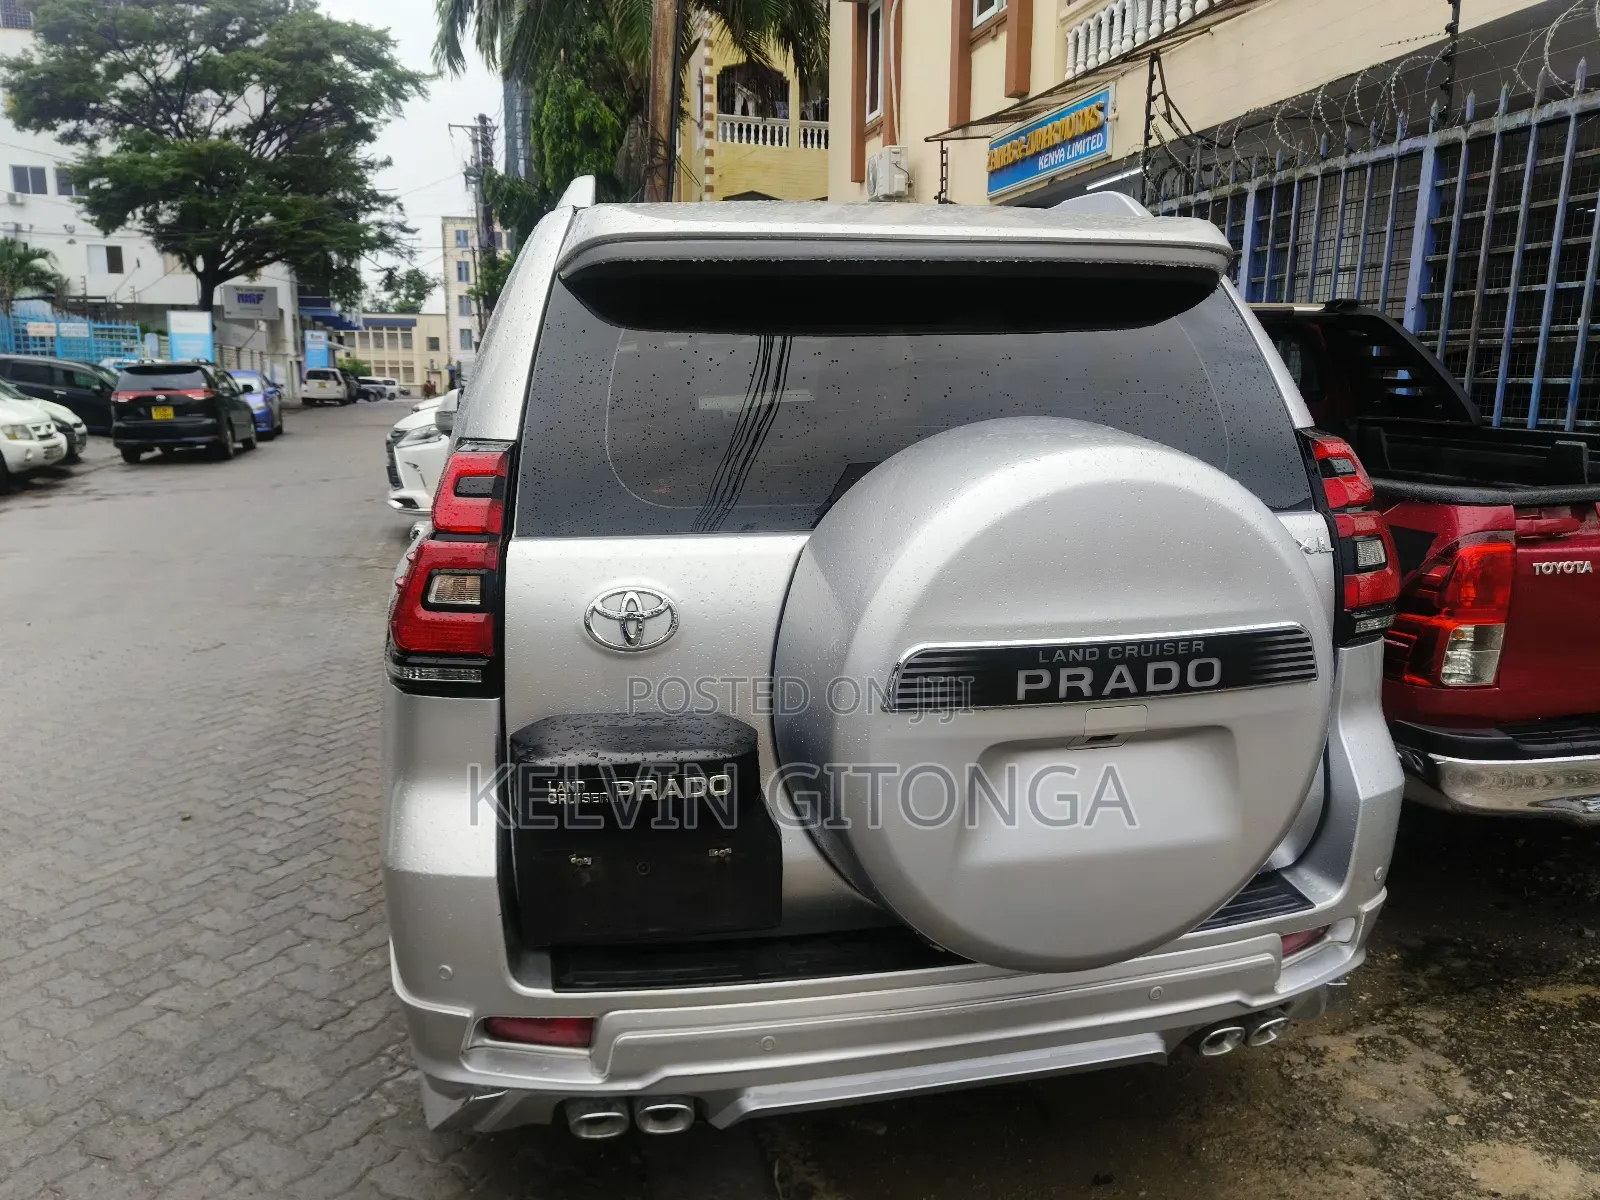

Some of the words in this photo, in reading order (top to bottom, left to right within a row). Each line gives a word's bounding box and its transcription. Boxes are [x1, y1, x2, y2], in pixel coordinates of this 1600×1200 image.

[1058, 101, 1105, 142] MOTORS
[1038, 149, 1065, 171] KENYA
[1066, 132, 1104, 160] LIMITED
[1532, 560, 1593, 576] TOYOTA
[1038, 647, 1100, 664] LAND
[1107, 640, 1205, 660] CRUISER
[1016, 657, 1222, 702] PRADO
[547, 780, 586, 793] LAND
[547, 792, 610, 805] CRUISER
[611, 774, 732, 803] PRADO
